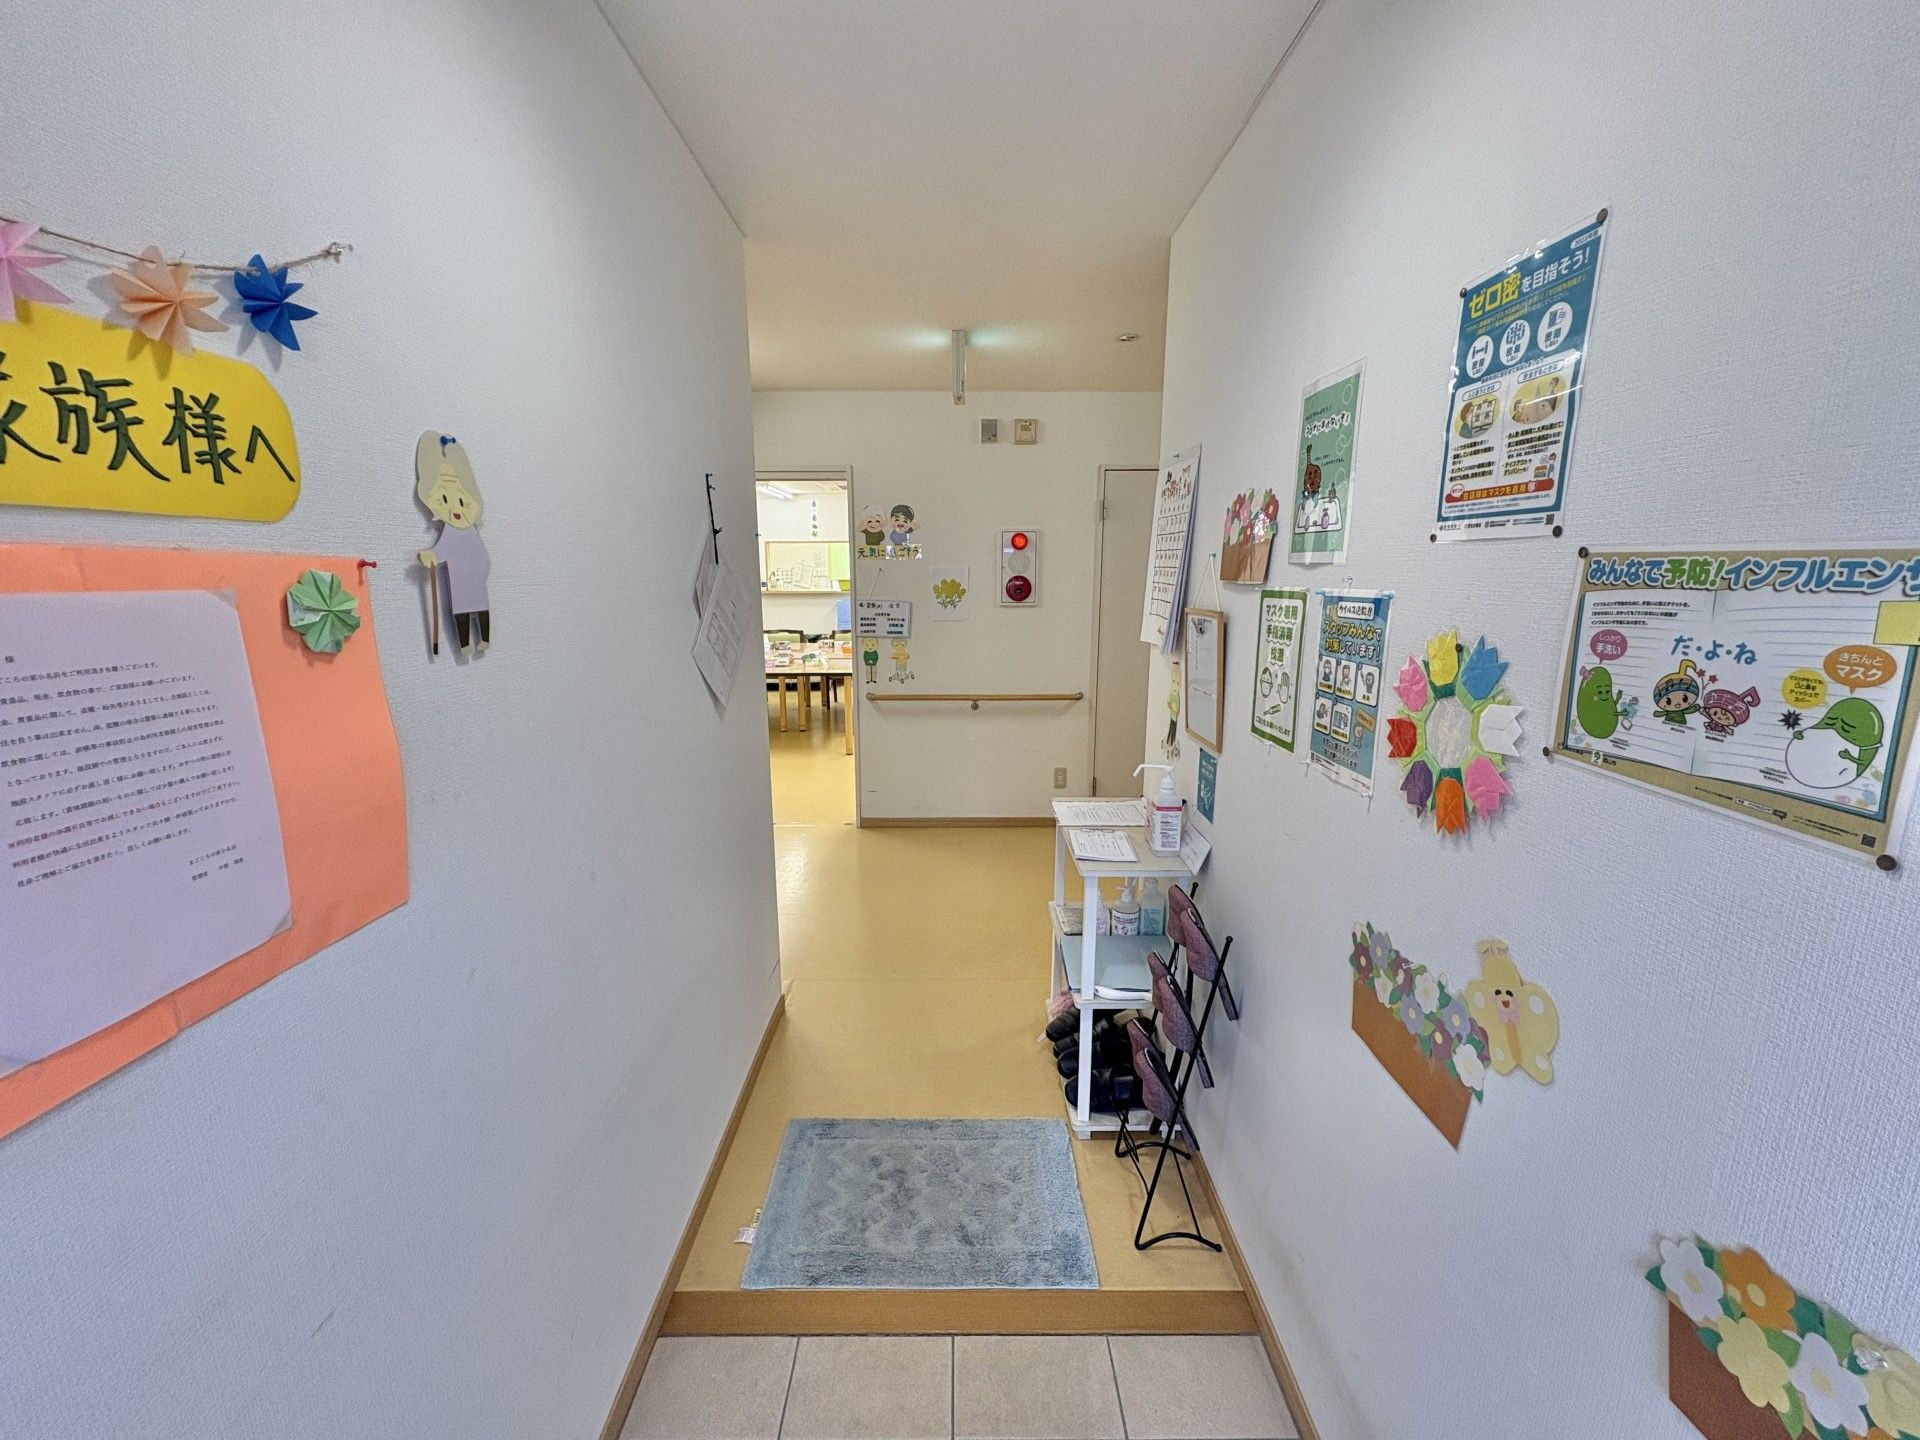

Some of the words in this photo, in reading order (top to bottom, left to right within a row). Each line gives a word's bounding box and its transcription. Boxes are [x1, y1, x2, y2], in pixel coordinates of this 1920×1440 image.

[1599, 635, 1621, 643] しっかり
[1595, 642, 1621, 655] 手洗い
[1839, 652, 1883, 666] きちんと
[1836, 664, 1883, 681] マスク
